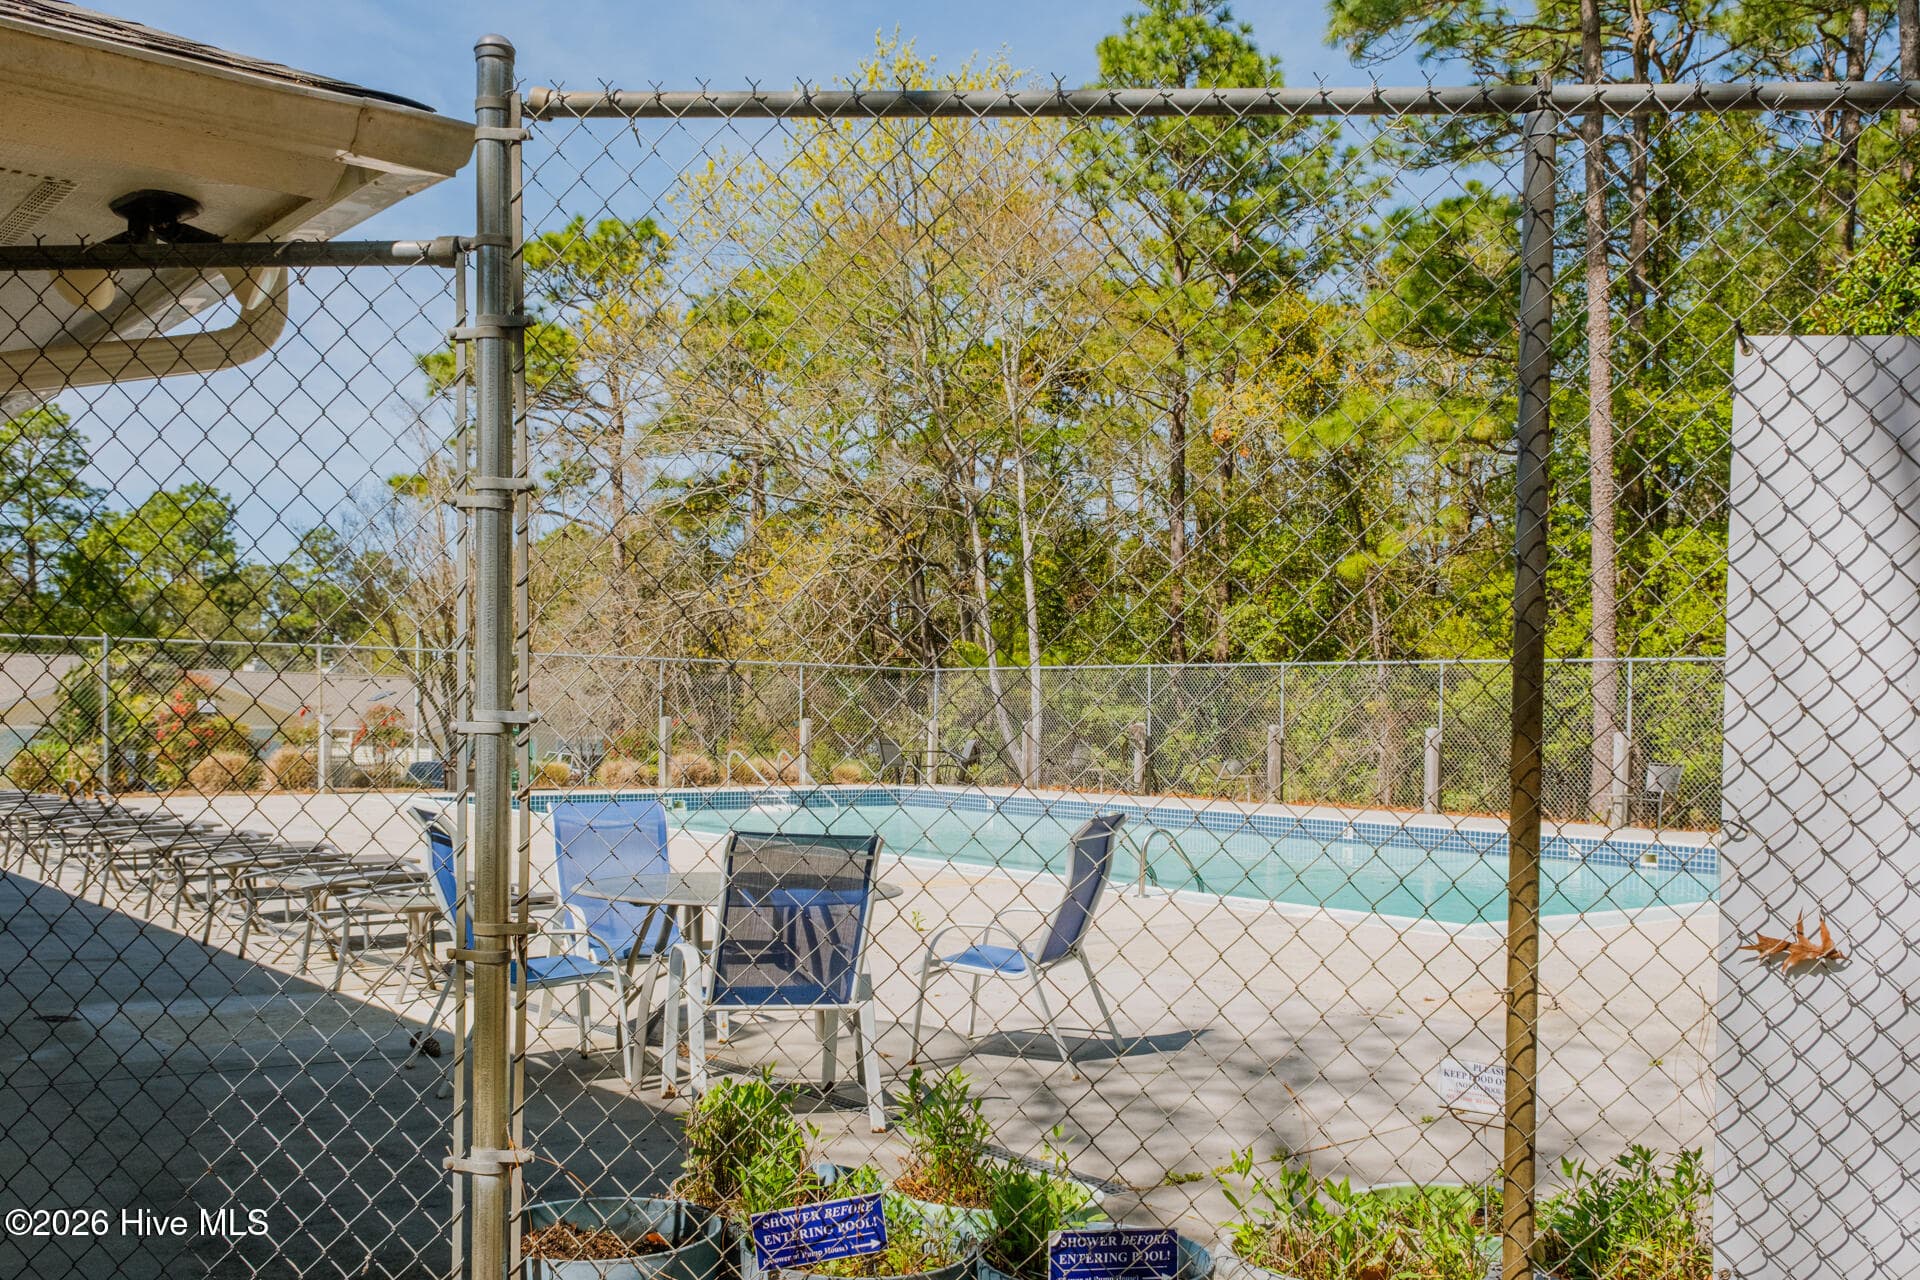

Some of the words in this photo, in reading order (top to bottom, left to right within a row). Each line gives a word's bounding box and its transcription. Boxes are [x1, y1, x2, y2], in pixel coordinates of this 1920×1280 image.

[1443, 1069, 1467, 1080] KEEP
[1468, 1073, 1493, 1084] FOOD
[762, 1210, 821, 1230] SHOWER
[824, 1200, 874, 1219] BEFORE
[837, 1216, 878, 1233] POOL!
[1060, 1235, 1117, 1248] SHOWER
[1121, 1234, 1170, 1246] BEFORE
[763, 1254, 791, 1266] (ower
[1059, 1251, 1128, 1265] ENTERING
[1132, 1250, 1171, 1262] POOL!
